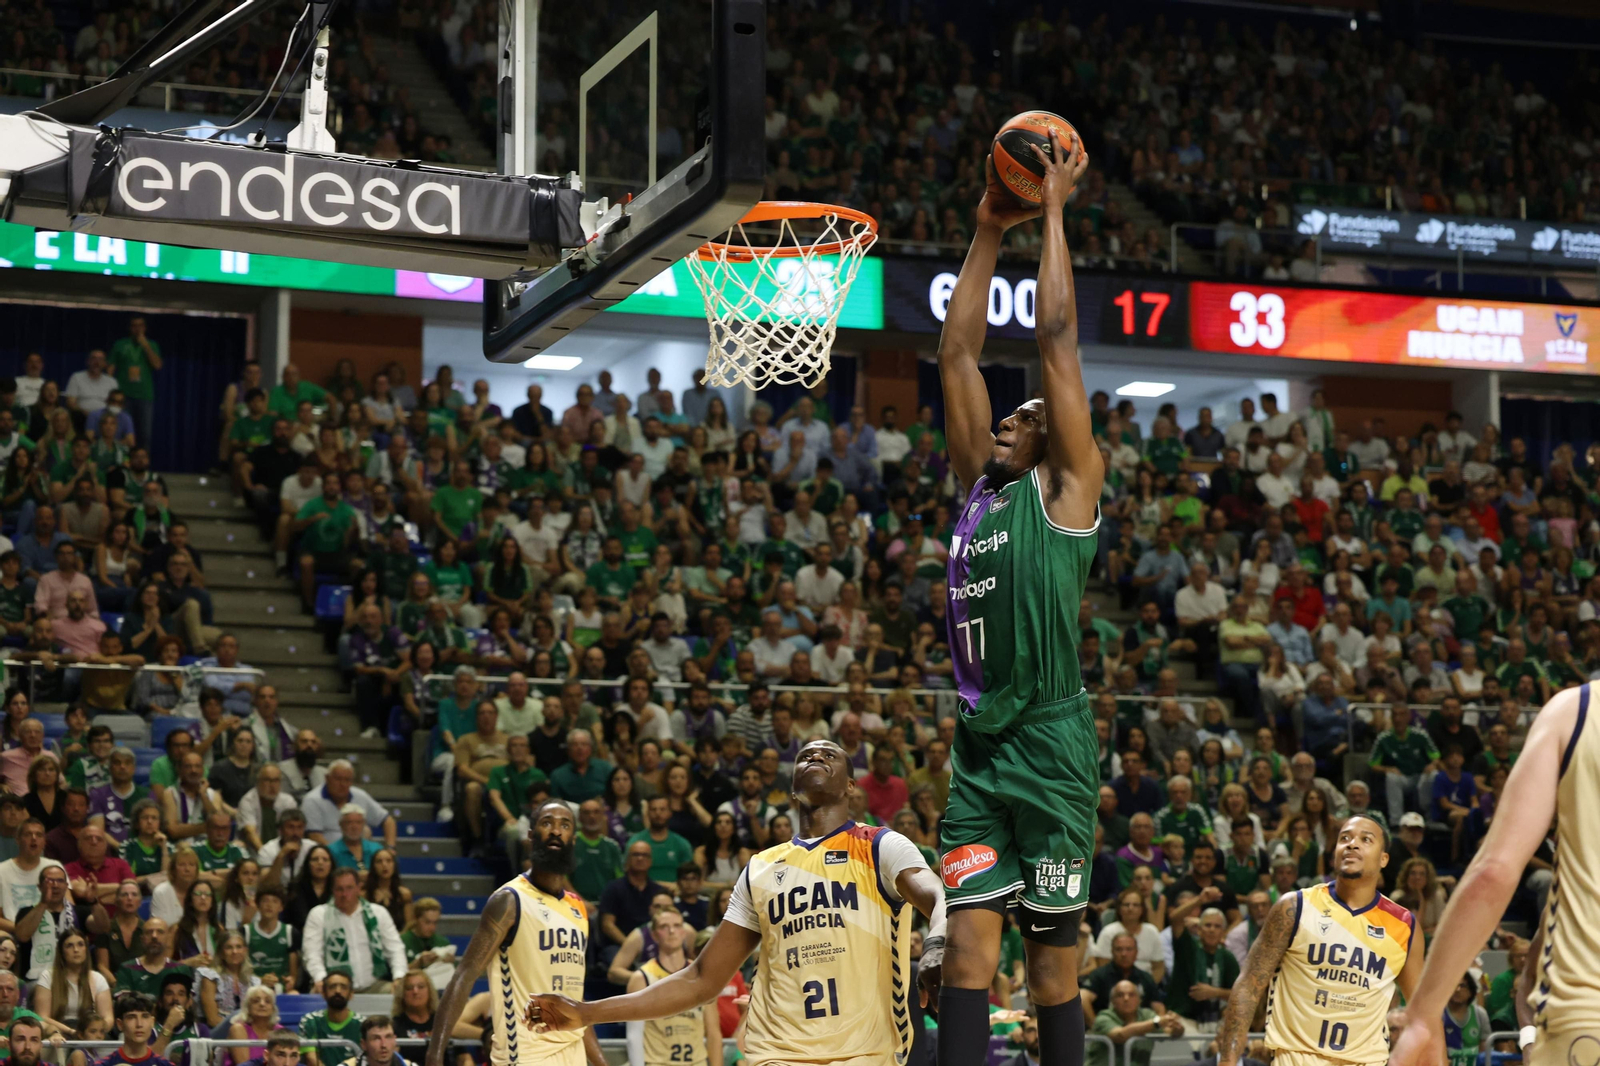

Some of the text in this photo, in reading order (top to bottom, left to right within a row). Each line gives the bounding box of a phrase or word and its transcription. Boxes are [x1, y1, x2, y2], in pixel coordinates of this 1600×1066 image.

[117, 154, 461, 236] endesa
[1114, 290, 1170, 337] 17
[1229, 291, 1286, 349] 33
[1436, 304, 1524, 336] UCAM
[1407, 329, 1524, 364] MURCIA
[956, 616, 985, 664] 77
[1035, 869, 1066, 892] laga
[768, 881, 859, 926] UCAM
[782, 913, 845, 939] MURCIA
[801, 942, 832, 952] CARAVACA
[1307, 943, 1387, 980] UCAM
[1316, 968, 1370, 990] MURCIA
[803, 978, 840, 1020] 21
[1318, 1019, 1349, 1051] 10
[670, 1044, 693, 1062] 22
